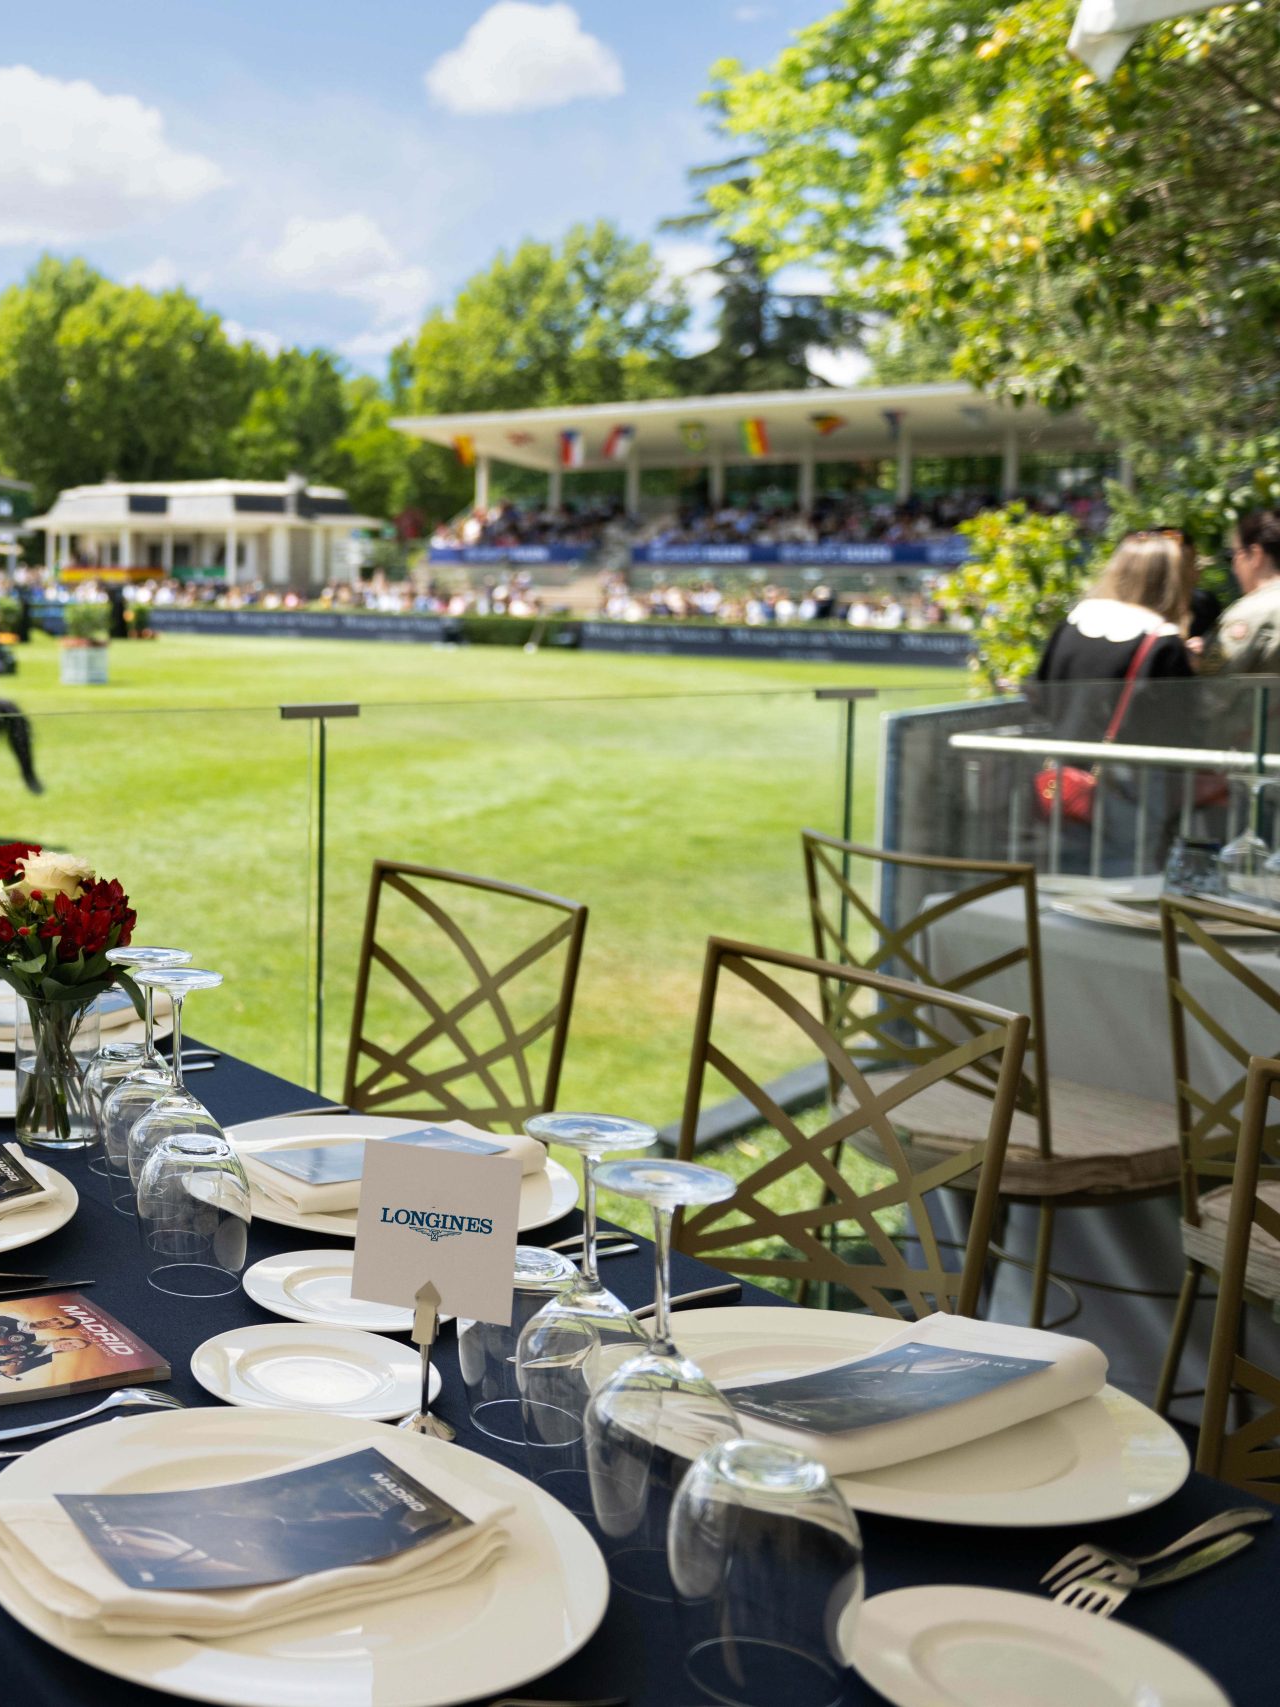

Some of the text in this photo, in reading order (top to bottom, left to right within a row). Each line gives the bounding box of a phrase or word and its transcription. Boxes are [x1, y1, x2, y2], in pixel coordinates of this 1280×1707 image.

[380, 1207, 493, 1235] LONGINES
[58, 1305, 135, 1356] MADRID
[369, 1472, 427, 1512] MADRID
